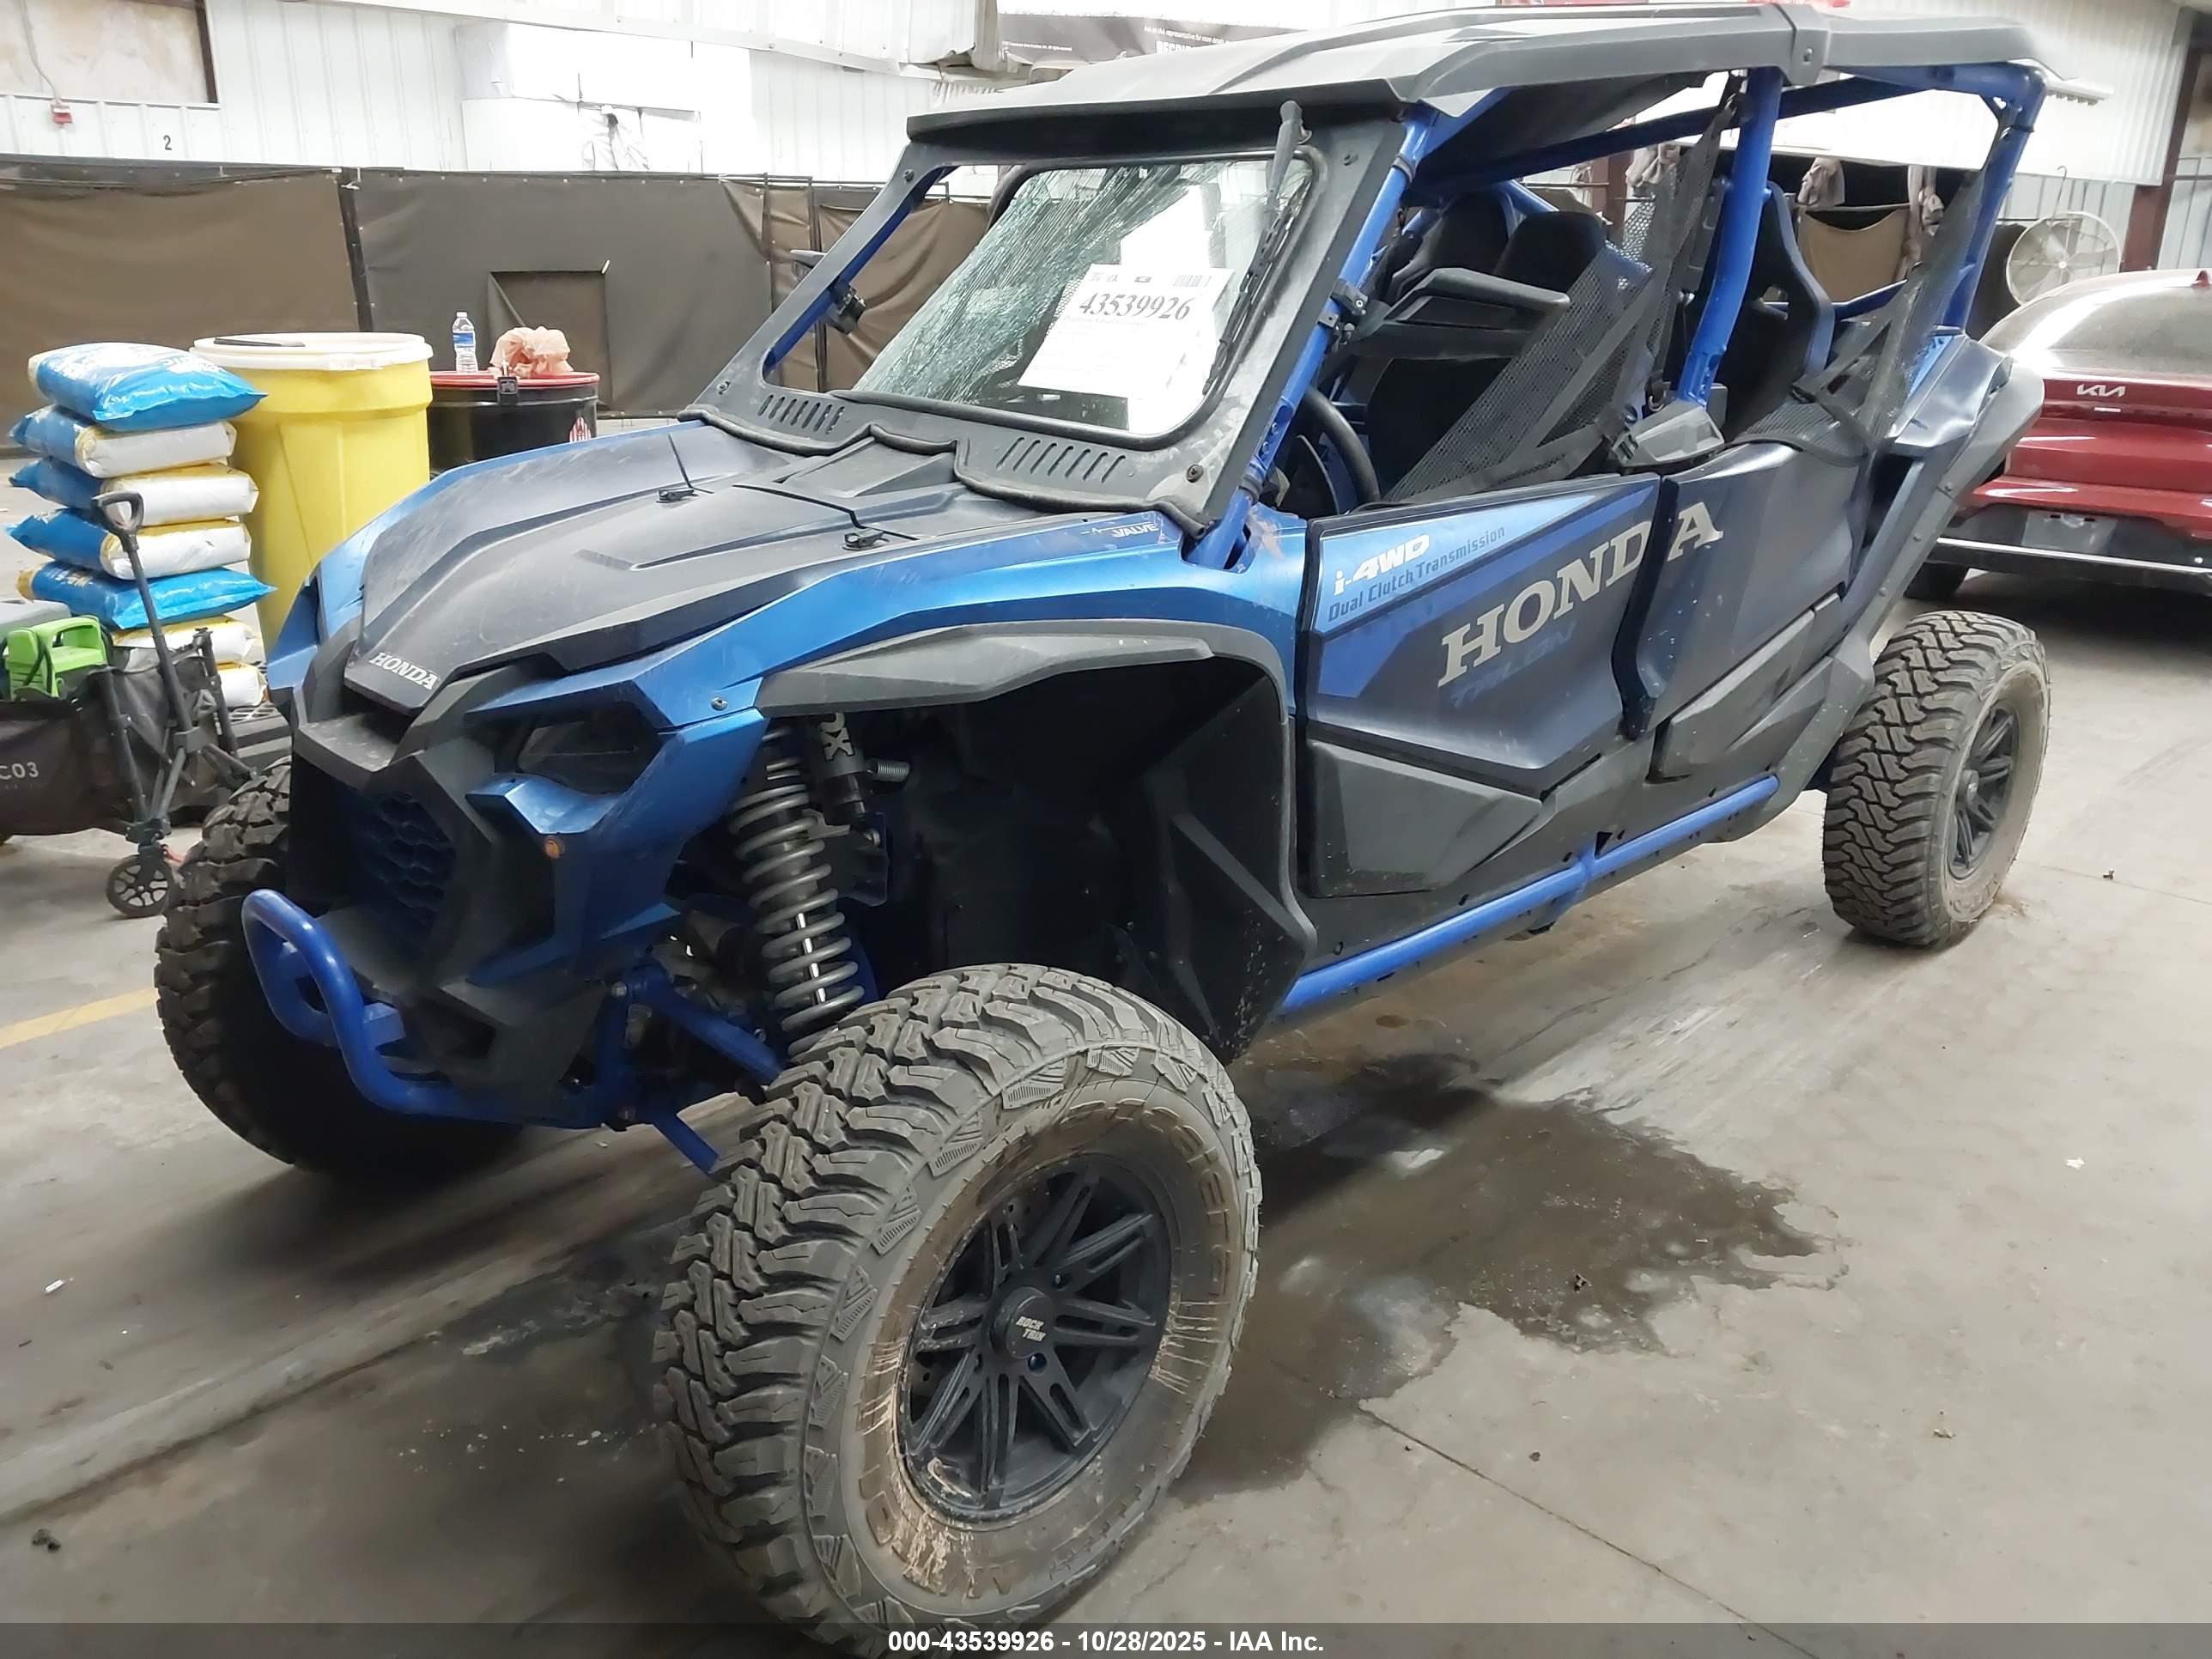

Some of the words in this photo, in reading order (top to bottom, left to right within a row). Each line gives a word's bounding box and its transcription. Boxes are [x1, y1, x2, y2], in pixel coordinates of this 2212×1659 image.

[163, 135, 172, 150] 2
[1079, 293, 1195, 320] 43539926
[2077, 384, 2126, 398] KIA
[1328, 591, 1363, 622] Dual
[1368, 569, 1413, 603] Clutch
[1417, 526, 1505, 580] Transmission
[1437, 501, 1723, 687] HONDA
[368, 652, 438, 690] HONDA
